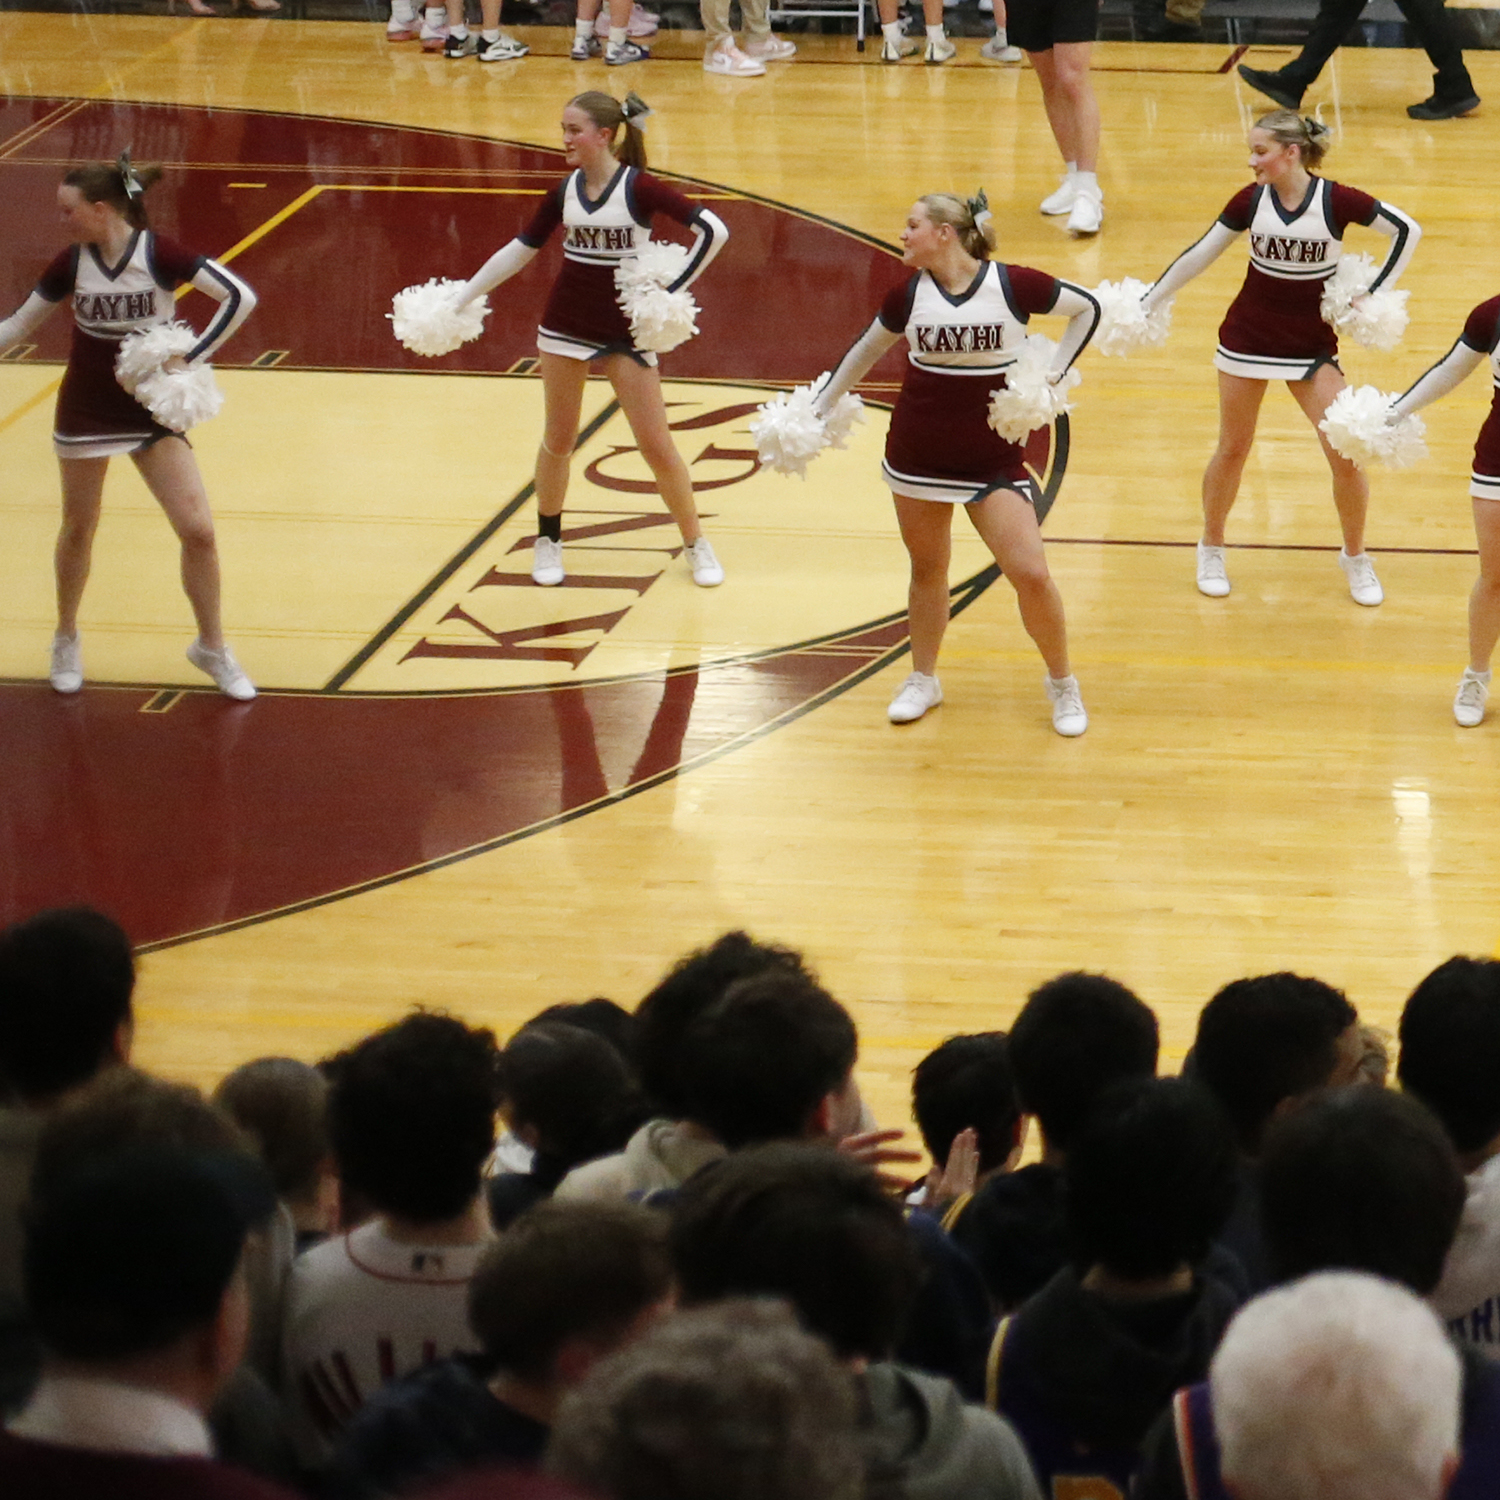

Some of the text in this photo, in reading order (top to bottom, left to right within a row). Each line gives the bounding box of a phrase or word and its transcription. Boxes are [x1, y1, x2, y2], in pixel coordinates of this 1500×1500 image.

[1251, 234, 1328, 263] KAYHI
[75, 291, 156, 320] KAYHI
[916, 324, 1003, 352] KAYHI
[397, 399, 783, 670] KINGS
